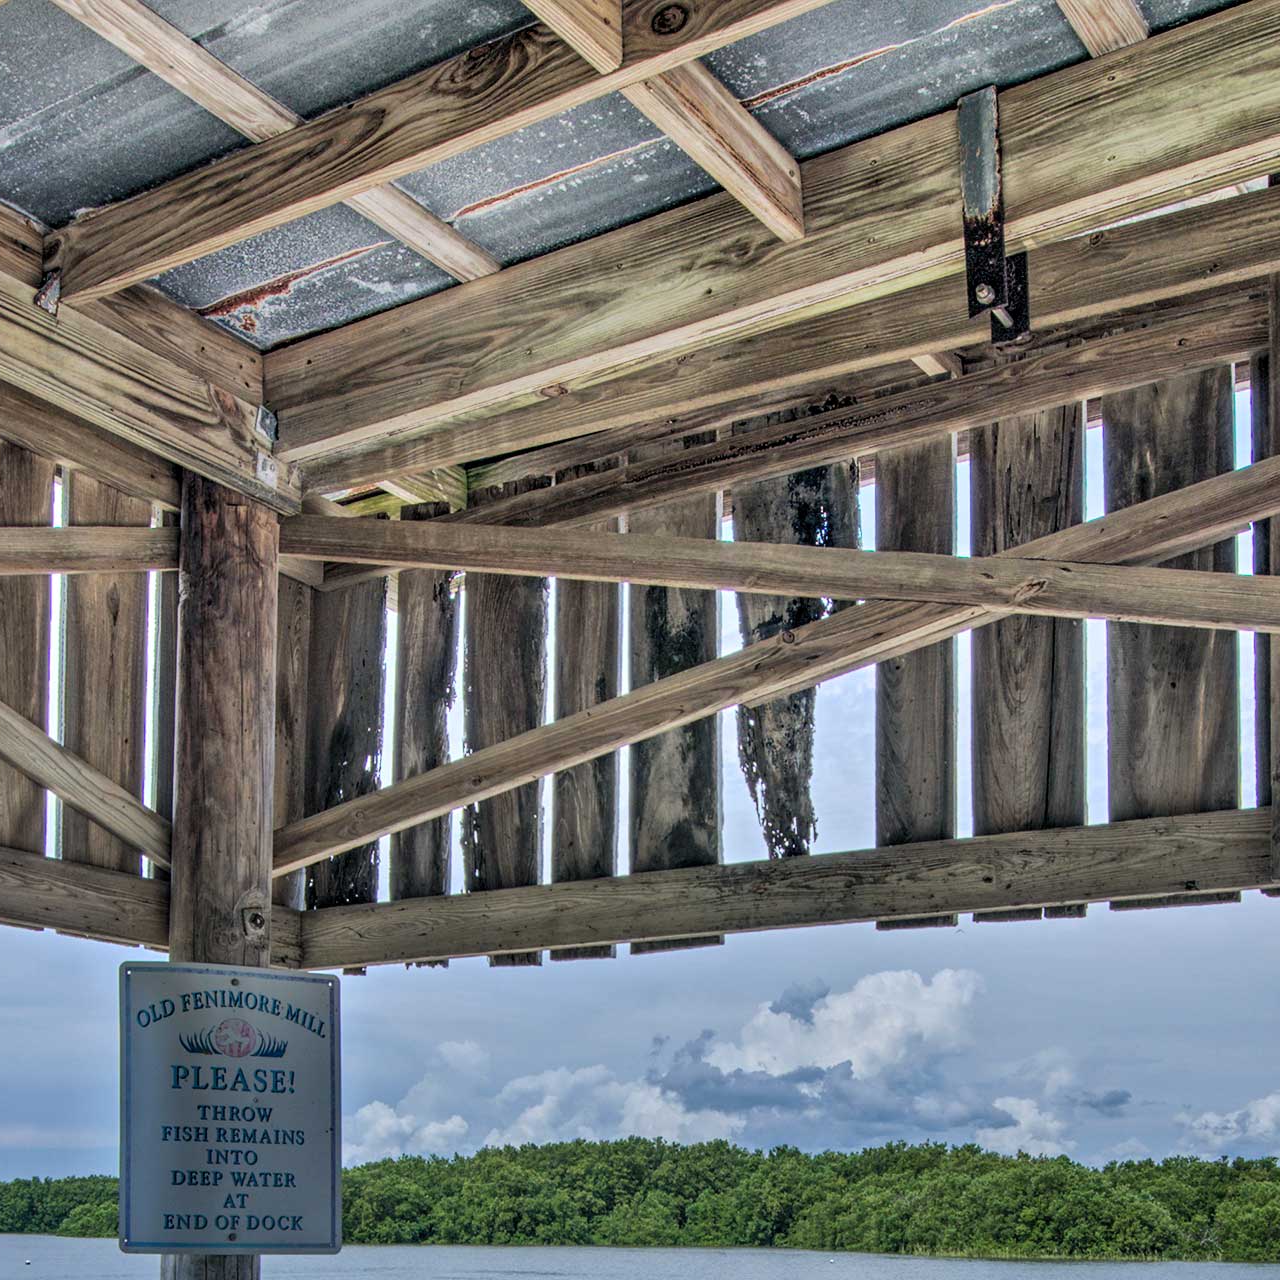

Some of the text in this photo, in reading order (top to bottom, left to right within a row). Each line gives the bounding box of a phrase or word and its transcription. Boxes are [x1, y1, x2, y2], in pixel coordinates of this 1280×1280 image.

[137, 990, 326, 1039] OLD FENIMORE MILL
[171, 1065, 295, 1094] PLEASE!
[197, 1105, 272, 1122] THROW
[162, 1126, 305, 1145] FISH REMAINS
[206, 1149, 258, 1165] INTO
[171, 1171, 296, 1188] DEEP WATER
[223, 1194, 248, 1208] AT
[163, 1215, 303, 1231] END OF DOCK
